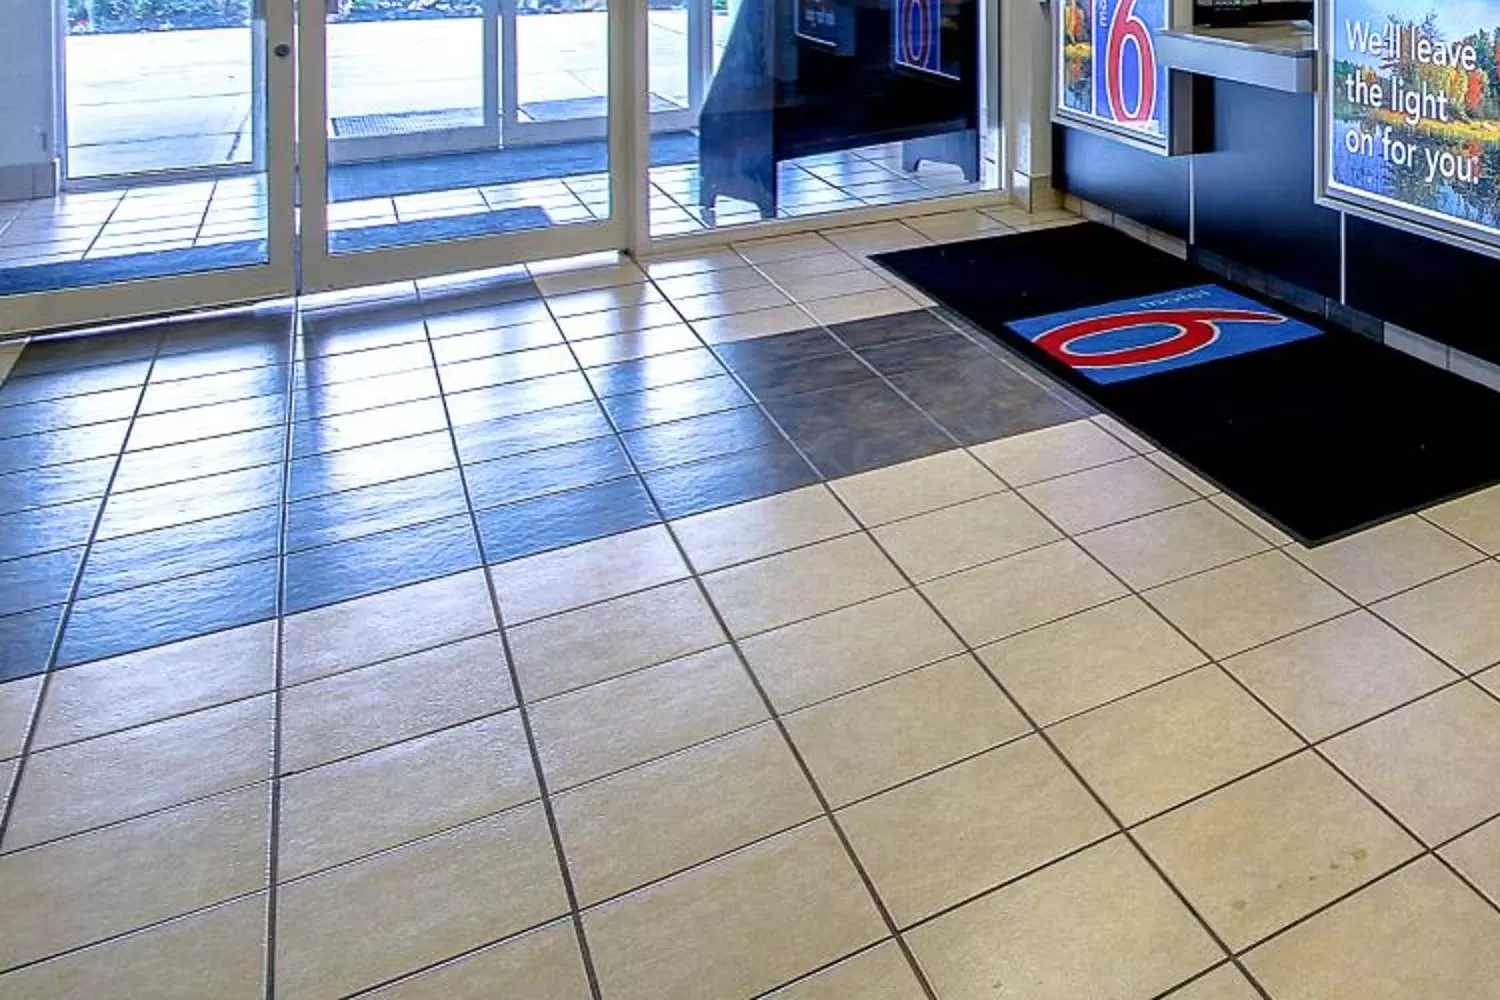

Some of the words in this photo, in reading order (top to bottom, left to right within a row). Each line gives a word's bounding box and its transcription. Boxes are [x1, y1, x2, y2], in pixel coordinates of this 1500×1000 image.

[1345, 19, 1400, 58] We'll
[1411, 26, 1477, 70] leave
[1346, 69, 1383, 106] the
[1392, 75, 1447, 125] light
[1345, 127, 1373, 156] on
[1381, 126, 1417, 167] for
